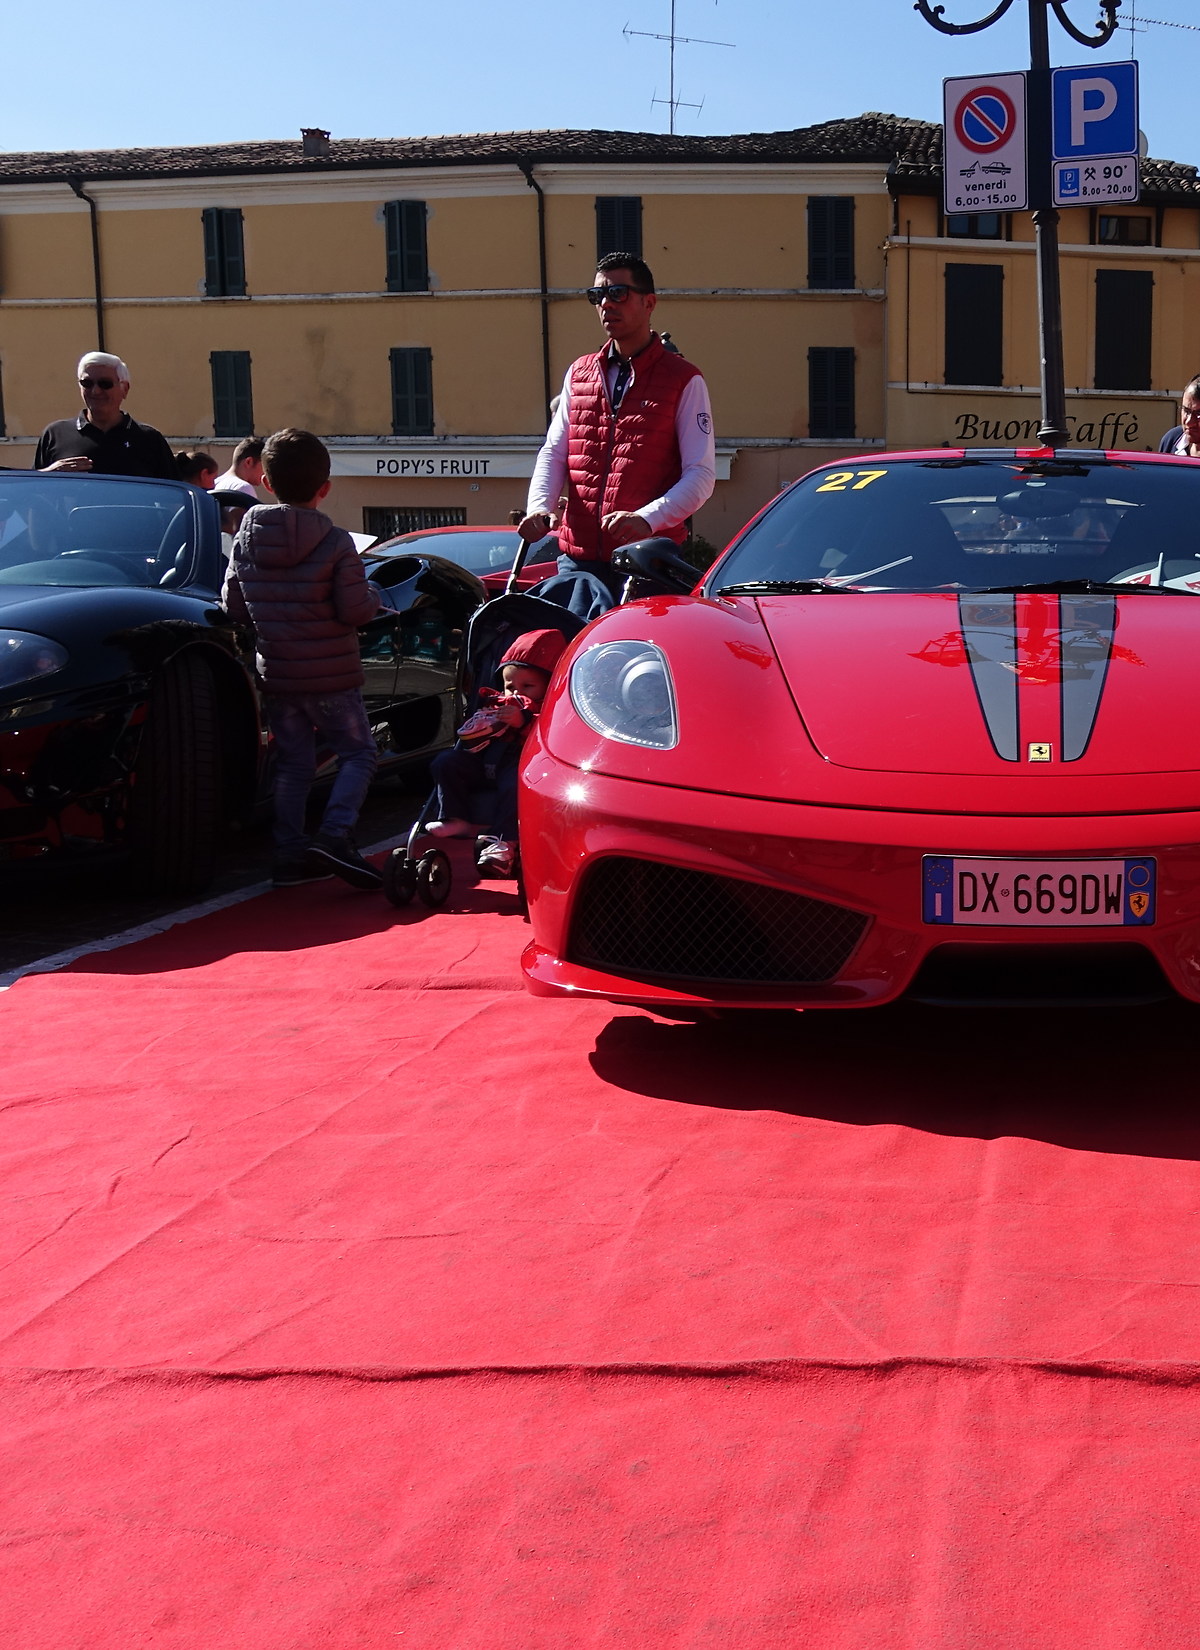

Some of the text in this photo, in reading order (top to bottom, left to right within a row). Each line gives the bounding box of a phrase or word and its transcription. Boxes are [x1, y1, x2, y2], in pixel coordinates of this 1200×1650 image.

[1070, 77, 1118, 147] P
[955, 413, 1042, 440] Buon
[376, 459, 490, 474] POPY'S FRUIT
[815, 470, 888, 493] 27
[958, 871, 999, 913] DX
[1013, 873, 1123, 915] 669DW
